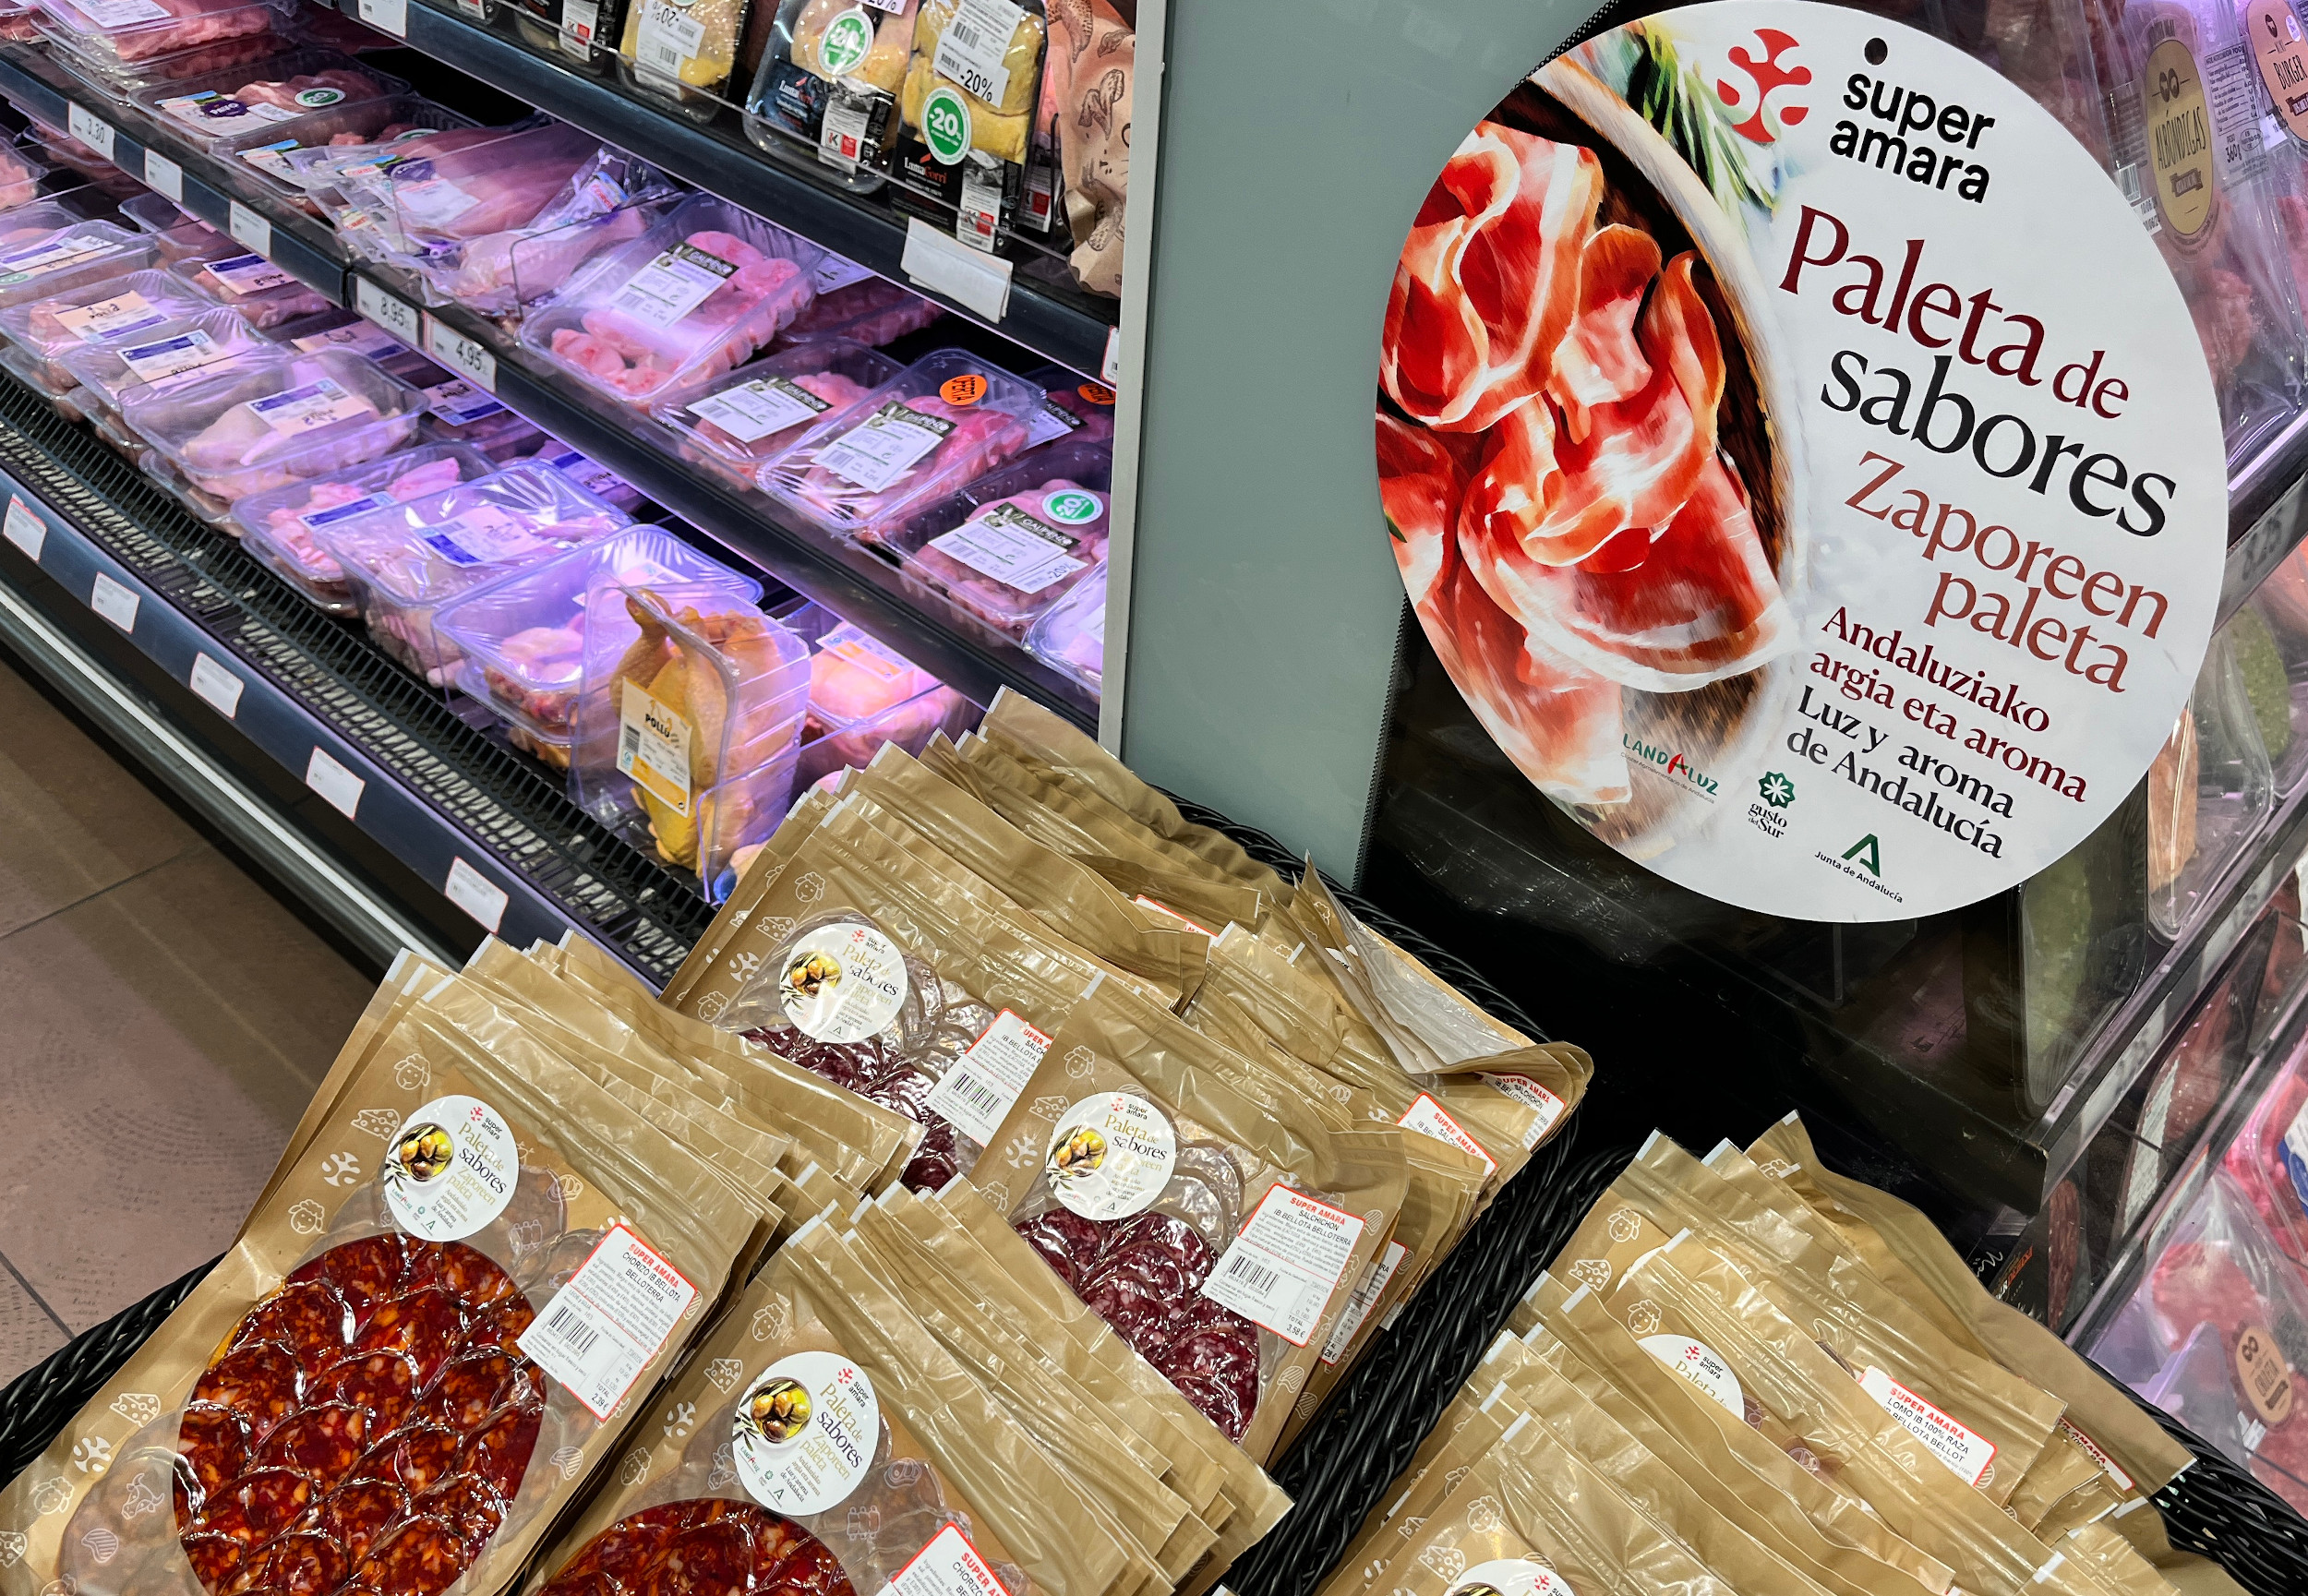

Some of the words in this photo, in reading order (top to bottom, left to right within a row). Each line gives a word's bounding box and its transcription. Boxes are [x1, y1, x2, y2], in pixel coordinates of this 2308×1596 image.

[960, 69, 992, 102] -20%
[2273, 54, 2308, 90] BURGER
[1844, 72, 1995, 150] super
[2155, 106, 2206, 171] ALBÓNDIGAS
[1830, 117, 1990, 203] amara
[380, 296, 405, 327] 8,95
[1778, 204, 2045, 387] Paleta
[2052, 350, 2129, 419] de
[456, 340, 482, 371] 4,95
[1821, 350, 2177, 537] sabores
[1845, 450, 2168, 640] Zaporeen
[1923, 571, 2126, 693] paleta
[1821, 606, 2050, 732] Andaluziako
[645, 714, 671, 738] POLLO
[1809, 652, 1894, 709] argia
[1903, 698, 1957, 740] eta
[1964, 727, 2086, 803] aroma
[1622, 733, 1719, 797] LANDALUZ
[1797, 685, 1859, 739] Luz
[1862, 726, 1889, 753] y
[1898, 745, 2013, 819] aroma
[1787, 727, 1828, 764] de
[1831, 750, 2002, 858] Andalucía
[1748, 803, 1787, 828] gusto
[1758, 819, 1785, 838] Sur
[1814, 851, 1842, 870] Junta
[1843, 865, 1856, 877] de
[1856, 872, 1904, 904] Andalucía
[842, 943, 881, 970] Paleta
[849, 964, 899, 996] sabores
[1025, 1040, 1046, 1055] SALCH
[1529, 1082, 1550, 1103] AMARA
[1126, 1110, 1148, 1120] amara
[1128, 1103, 1148, 1114] super
[481, 1122, 500, 1140] amara
[485, 1117, 502, 1134] super
[1104, 1114, 1147, 1141] Paleta
[1147, 1135, 1160, 1145] de
[458, 1122, 493, 1163] Paleta
[492, 1158, 504, 1172] de
[1112, 1136, 1168, 1160] sabores
[1456, 1134, 1481, 1158] AMAR
[457, 1167, 497, 1206] Zaporeen
[459, 1148, 507, 1194] sabores
[447, 1175, 473, 1201] paleta
[1290, 1197, 1316, 1213] SUPER
[1318, 1209, 1345, 1226] AMARA
[1298, 1209, 1340, 1231] SALCHICHON
[1311, 1225, 1352, 1247] BELLOTERRA
[622, 1252, 654, 1278] CHORIZO
[628, 1243, 655, 1266] SUPER
[654, 1265, 679, 1289] AMARA
[626, 1269, 664, 1302] BELLOTERRA
[1288, 1314, 1304, 1326] TOTAL
[1298, 1329, 1305, 1338] €
[1699, 1361, 1721, 1379] amara
[1702, 1356, 1723, 1373] super
[591, 1393, 605, 1408] 2,39
[595, 1383, 609, 1398] TOTAL
[848, 1386, 866, 1408] amara
[853, 1381, 870, 1400] super
[820, 1382, 857, 1432] Paleta
[852, 1425, 862, 1443] de
[1888, 1398, 1914, 1418] LOMO
[1945, 1435, 1968, 1454] RAZA
[1890, 1388, 1925, 1413] SUPER
[1926, 1412, 1965, 1440] AMARA
[799, 1440, 827, 1471] paleta
[816, 1411, 863, 1469] sabores
[1929, 1436, 1965, 1462] BELLOT
[812, 1432, 851, 1481] Zaporeen
[961, 1552, 990, 1588] SUPER
